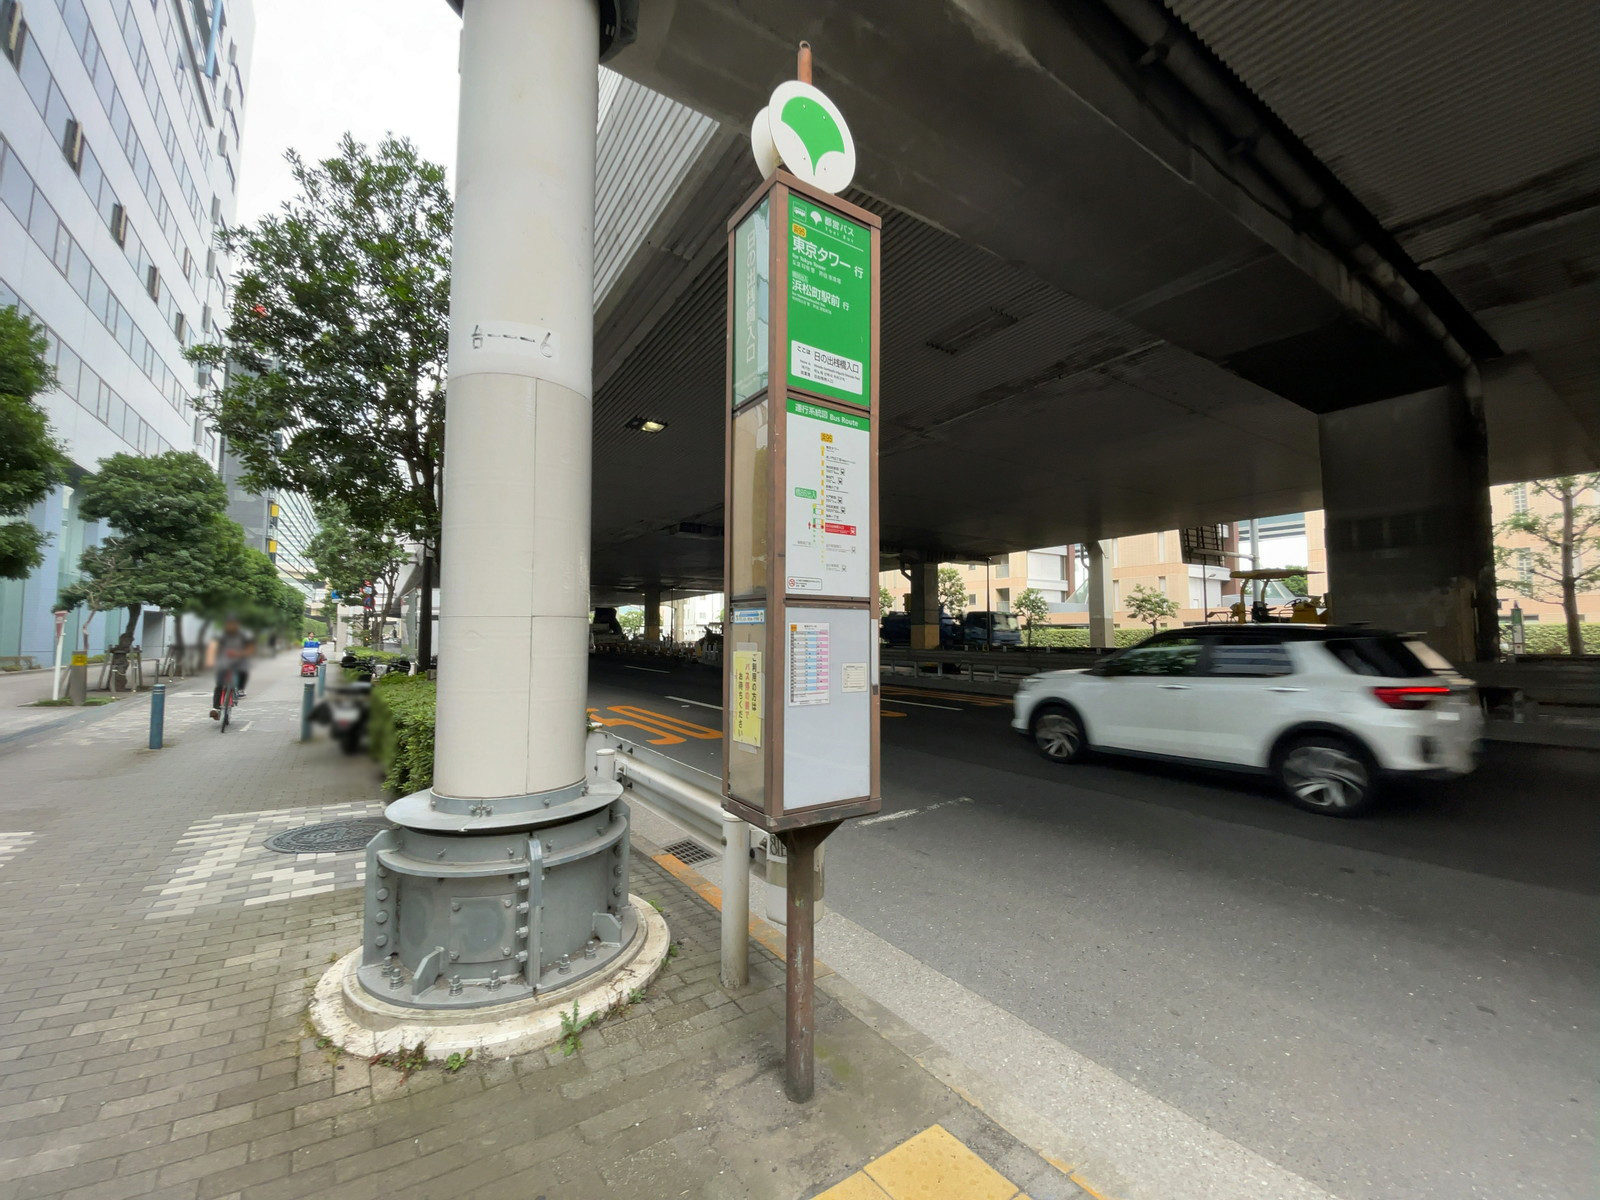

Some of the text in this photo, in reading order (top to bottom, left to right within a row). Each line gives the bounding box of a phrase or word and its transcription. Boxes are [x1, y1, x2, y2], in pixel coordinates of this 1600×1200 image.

[792, 235, 851, 268] 東京タワー
[854, 265, 864, 279] 行
[746, 229, 757, 364] 日の出桟橋入口
[792, 278, 840, 308] 浜松町駅前
[843, 301, 850, 311] 行
[814, 351, 859, 374] 日の出桟橋入口
[829, 413, 841, 423] Bus
[841, 416, 859, 427] Route
